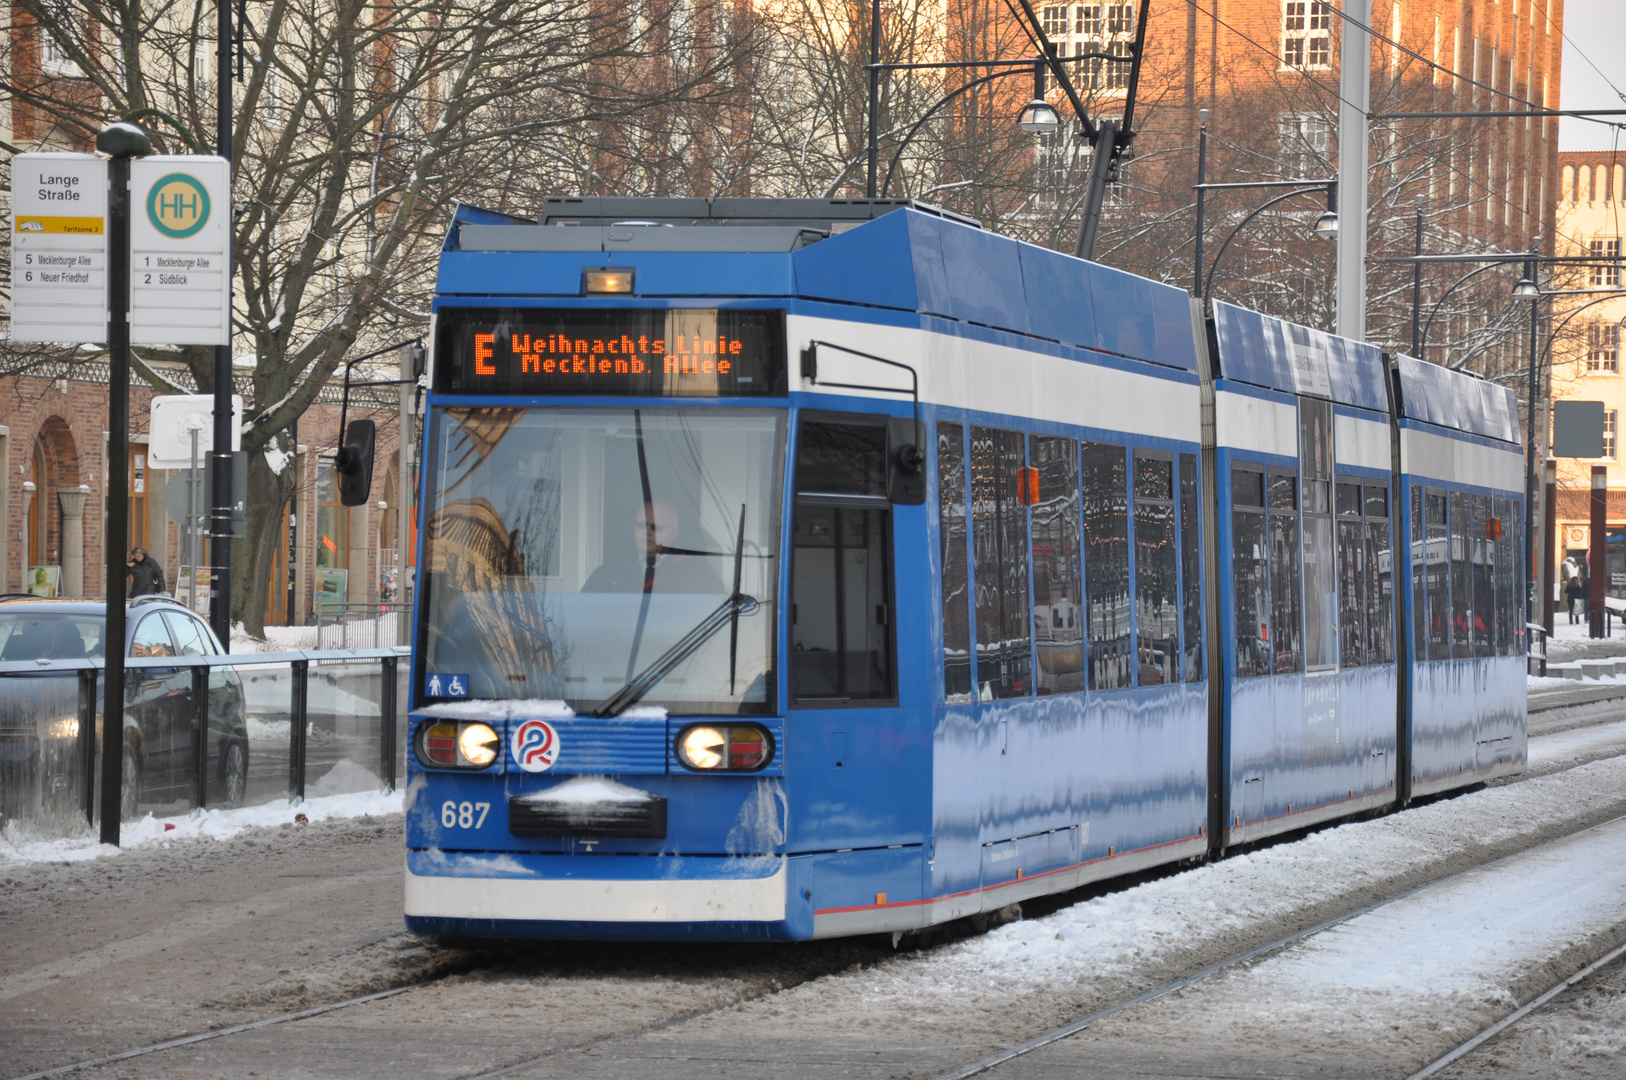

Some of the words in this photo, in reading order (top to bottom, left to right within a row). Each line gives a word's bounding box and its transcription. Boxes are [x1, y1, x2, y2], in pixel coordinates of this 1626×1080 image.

[39, 173, 79, 187] Lange
[38, 189, 80, 201] Straße
[25, 254, 33, 265] 5
[38, 254, 77, 267] Mecklenburger
[77, 255, 91, 266] Allee
[144, 256, 150, 267] 1
[157, 257, 196, 270] Mecklenburger
[196, 257, 210, 268] Allee
[25, 271, 33, 282] 6
[40, 272, 60, 283] Neuer
[61, 272, 89, 284] Friedhof
[144, 273, 152, 285] 2
[159, 273, 188, 285] Südblick
[474, 333, 497, 375] E
[511, 333, 665, 355] Weihnachts
[677, 334, 743, 355] Linie
[521, 353, 652, 374] Mecklenb.
[663, 354, 731, 374] Allee
[441, 800, 491, 830] 687
